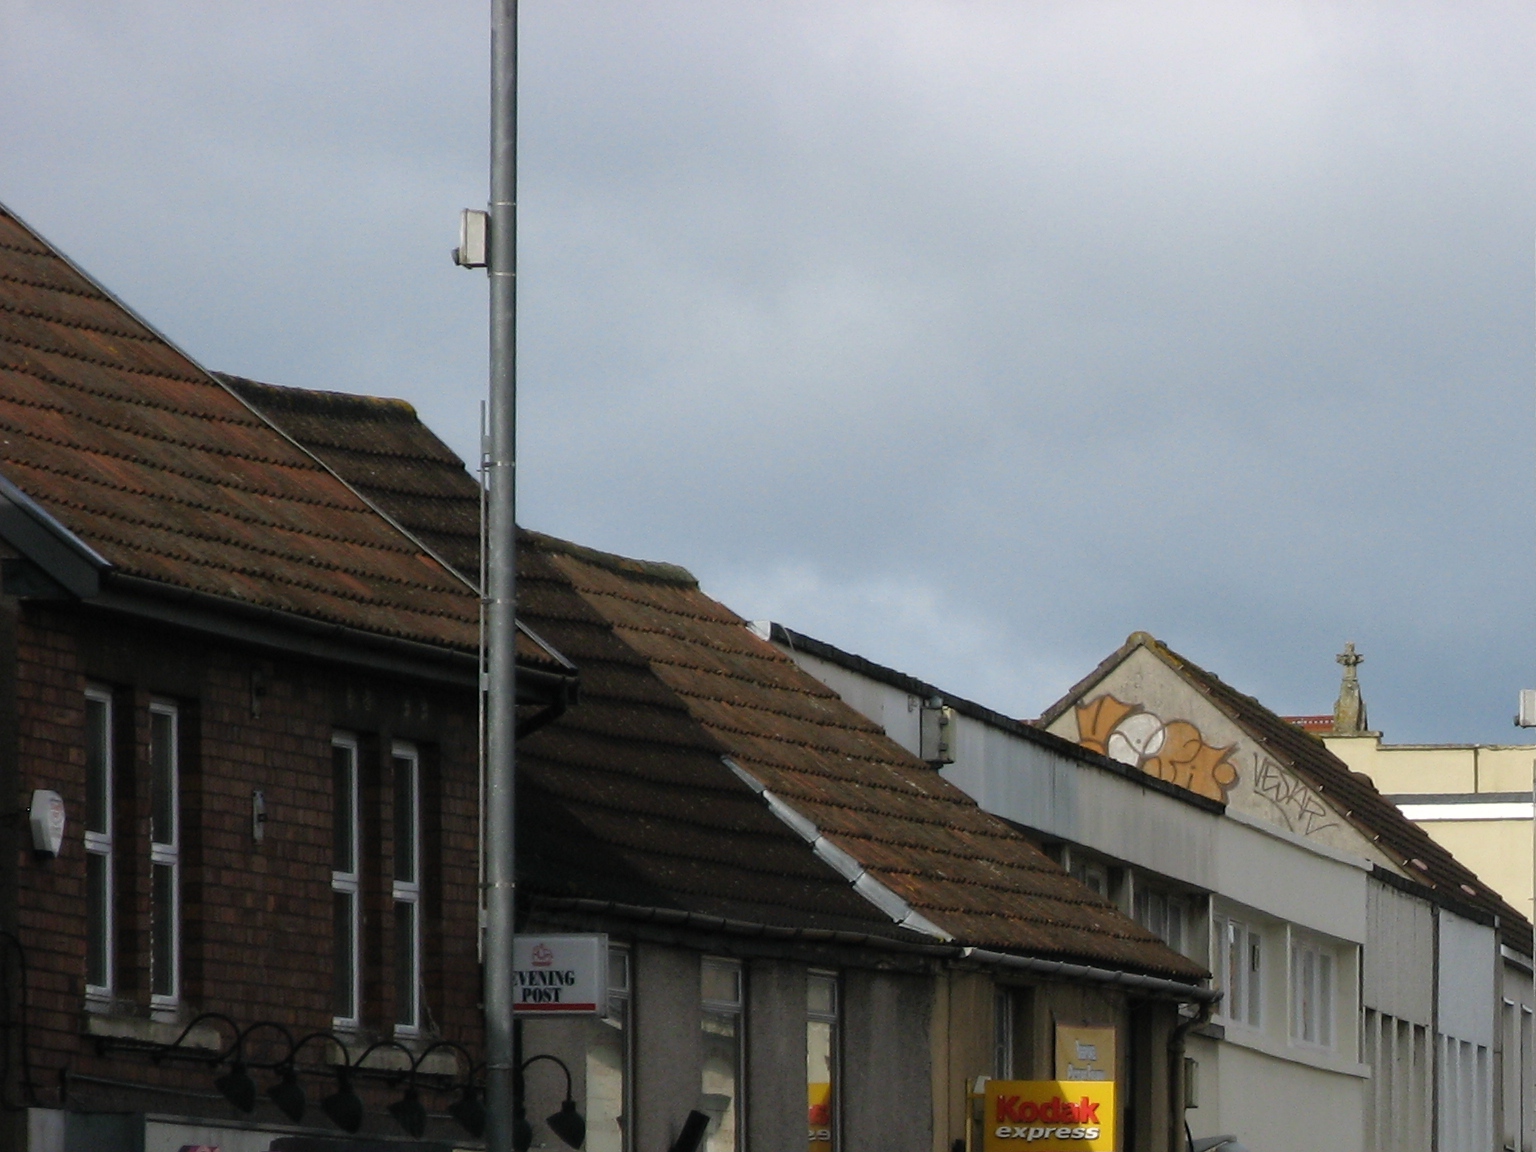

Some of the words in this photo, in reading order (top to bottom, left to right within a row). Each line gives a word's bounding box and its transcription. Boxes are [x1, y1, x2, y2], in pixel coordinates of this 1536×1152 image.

[522, 988, 562, 1003] POST
[996, 1095, 1100, 1124] Kodak
[994, 1126, 1100, 1141] express
